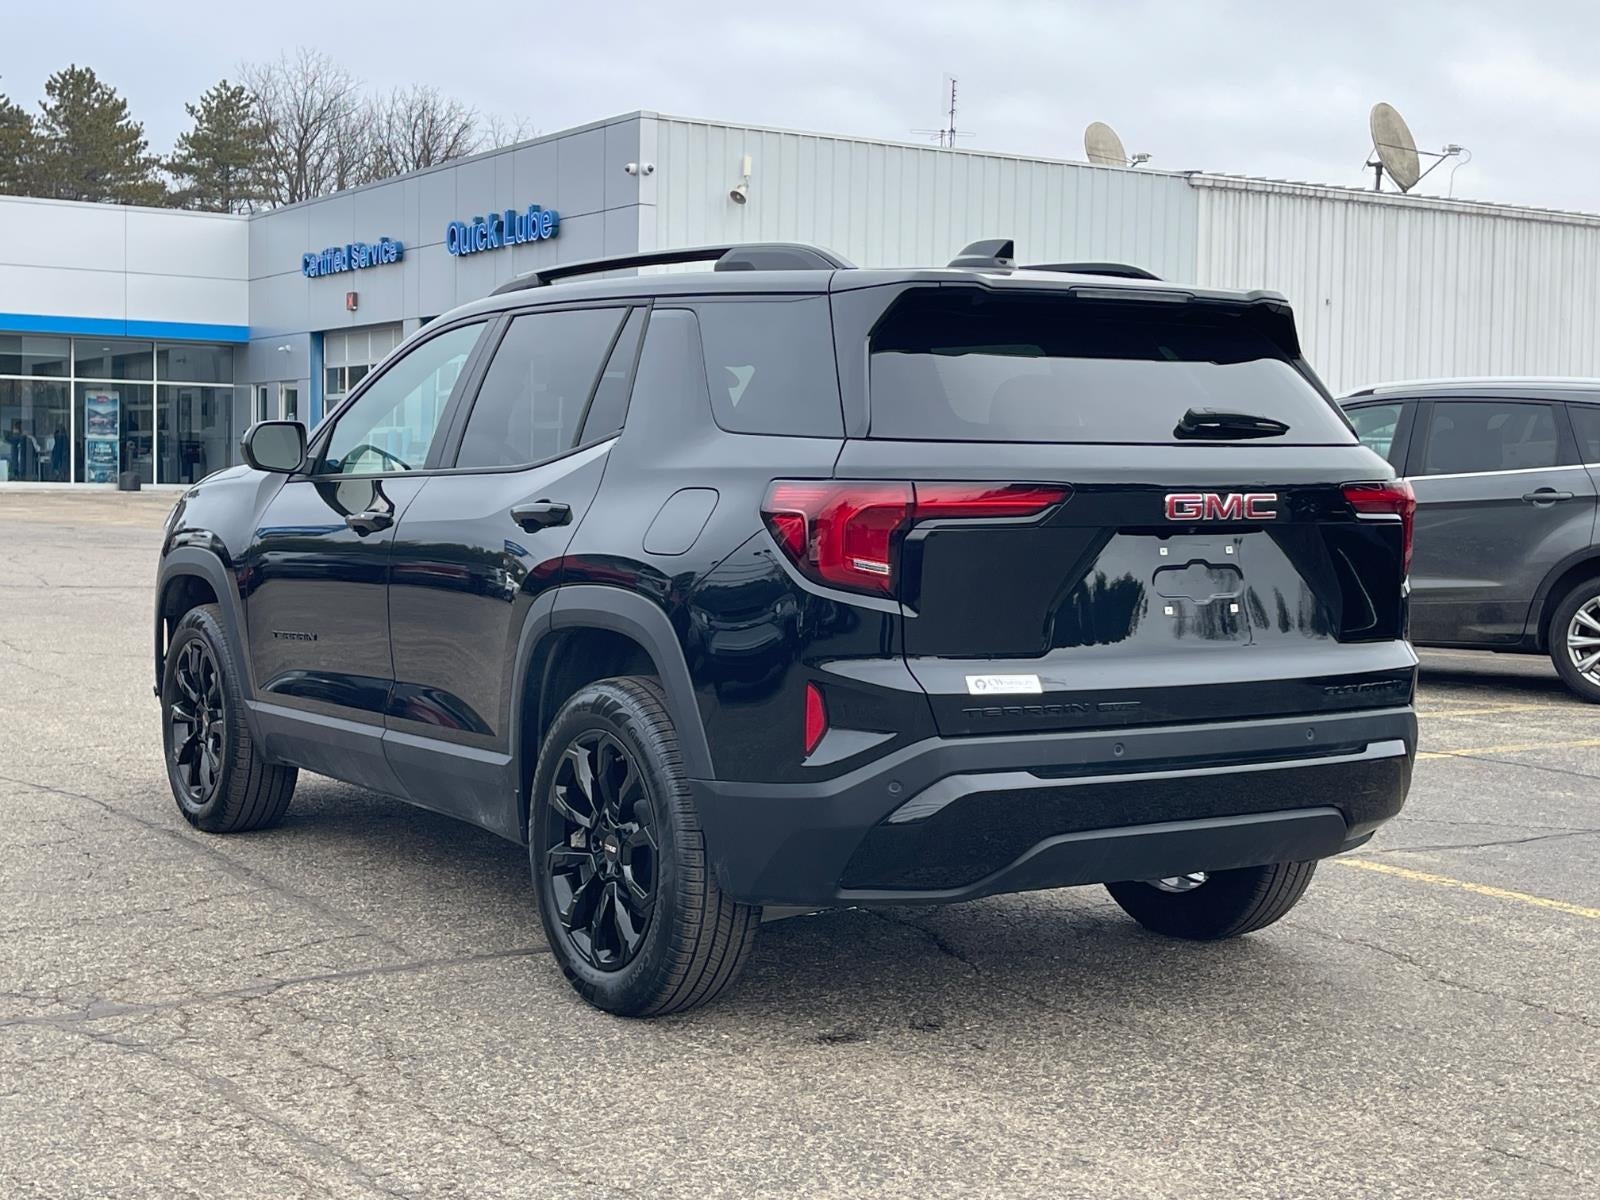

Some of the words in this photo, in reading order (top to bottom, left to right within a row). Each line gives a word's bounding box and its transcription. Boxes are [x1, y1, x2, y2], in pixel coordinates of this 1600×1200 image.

[446, 213, 501, 256] Quick
[501, 204, 558, 246] Lube
[302, 247, 349, 278] Certified
[350, 237, 403, 270] Service
[1164, 492, 1278, 521] GMC
